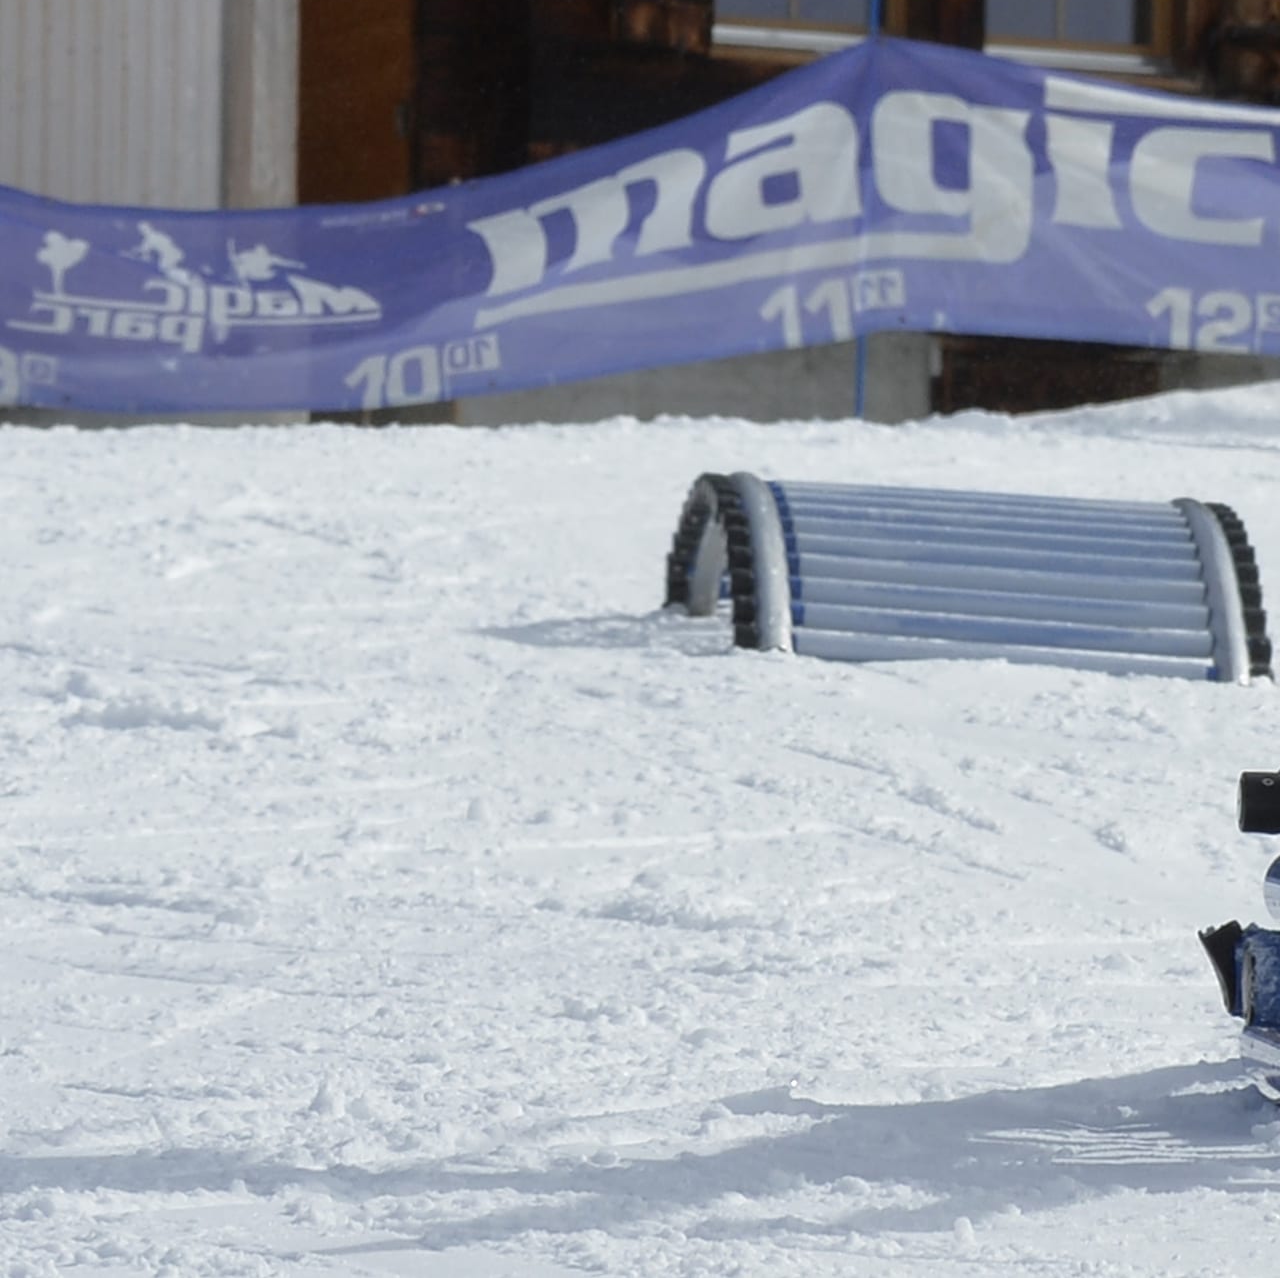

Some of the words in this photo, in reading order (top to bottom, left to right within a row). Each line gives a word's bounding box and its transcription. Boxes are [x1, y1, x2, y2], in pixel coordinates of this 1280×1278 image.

[759, 278, 853, 350] 11
[1144, 294, 1252, 353] 12
[345, 345, 441, 409] 10
